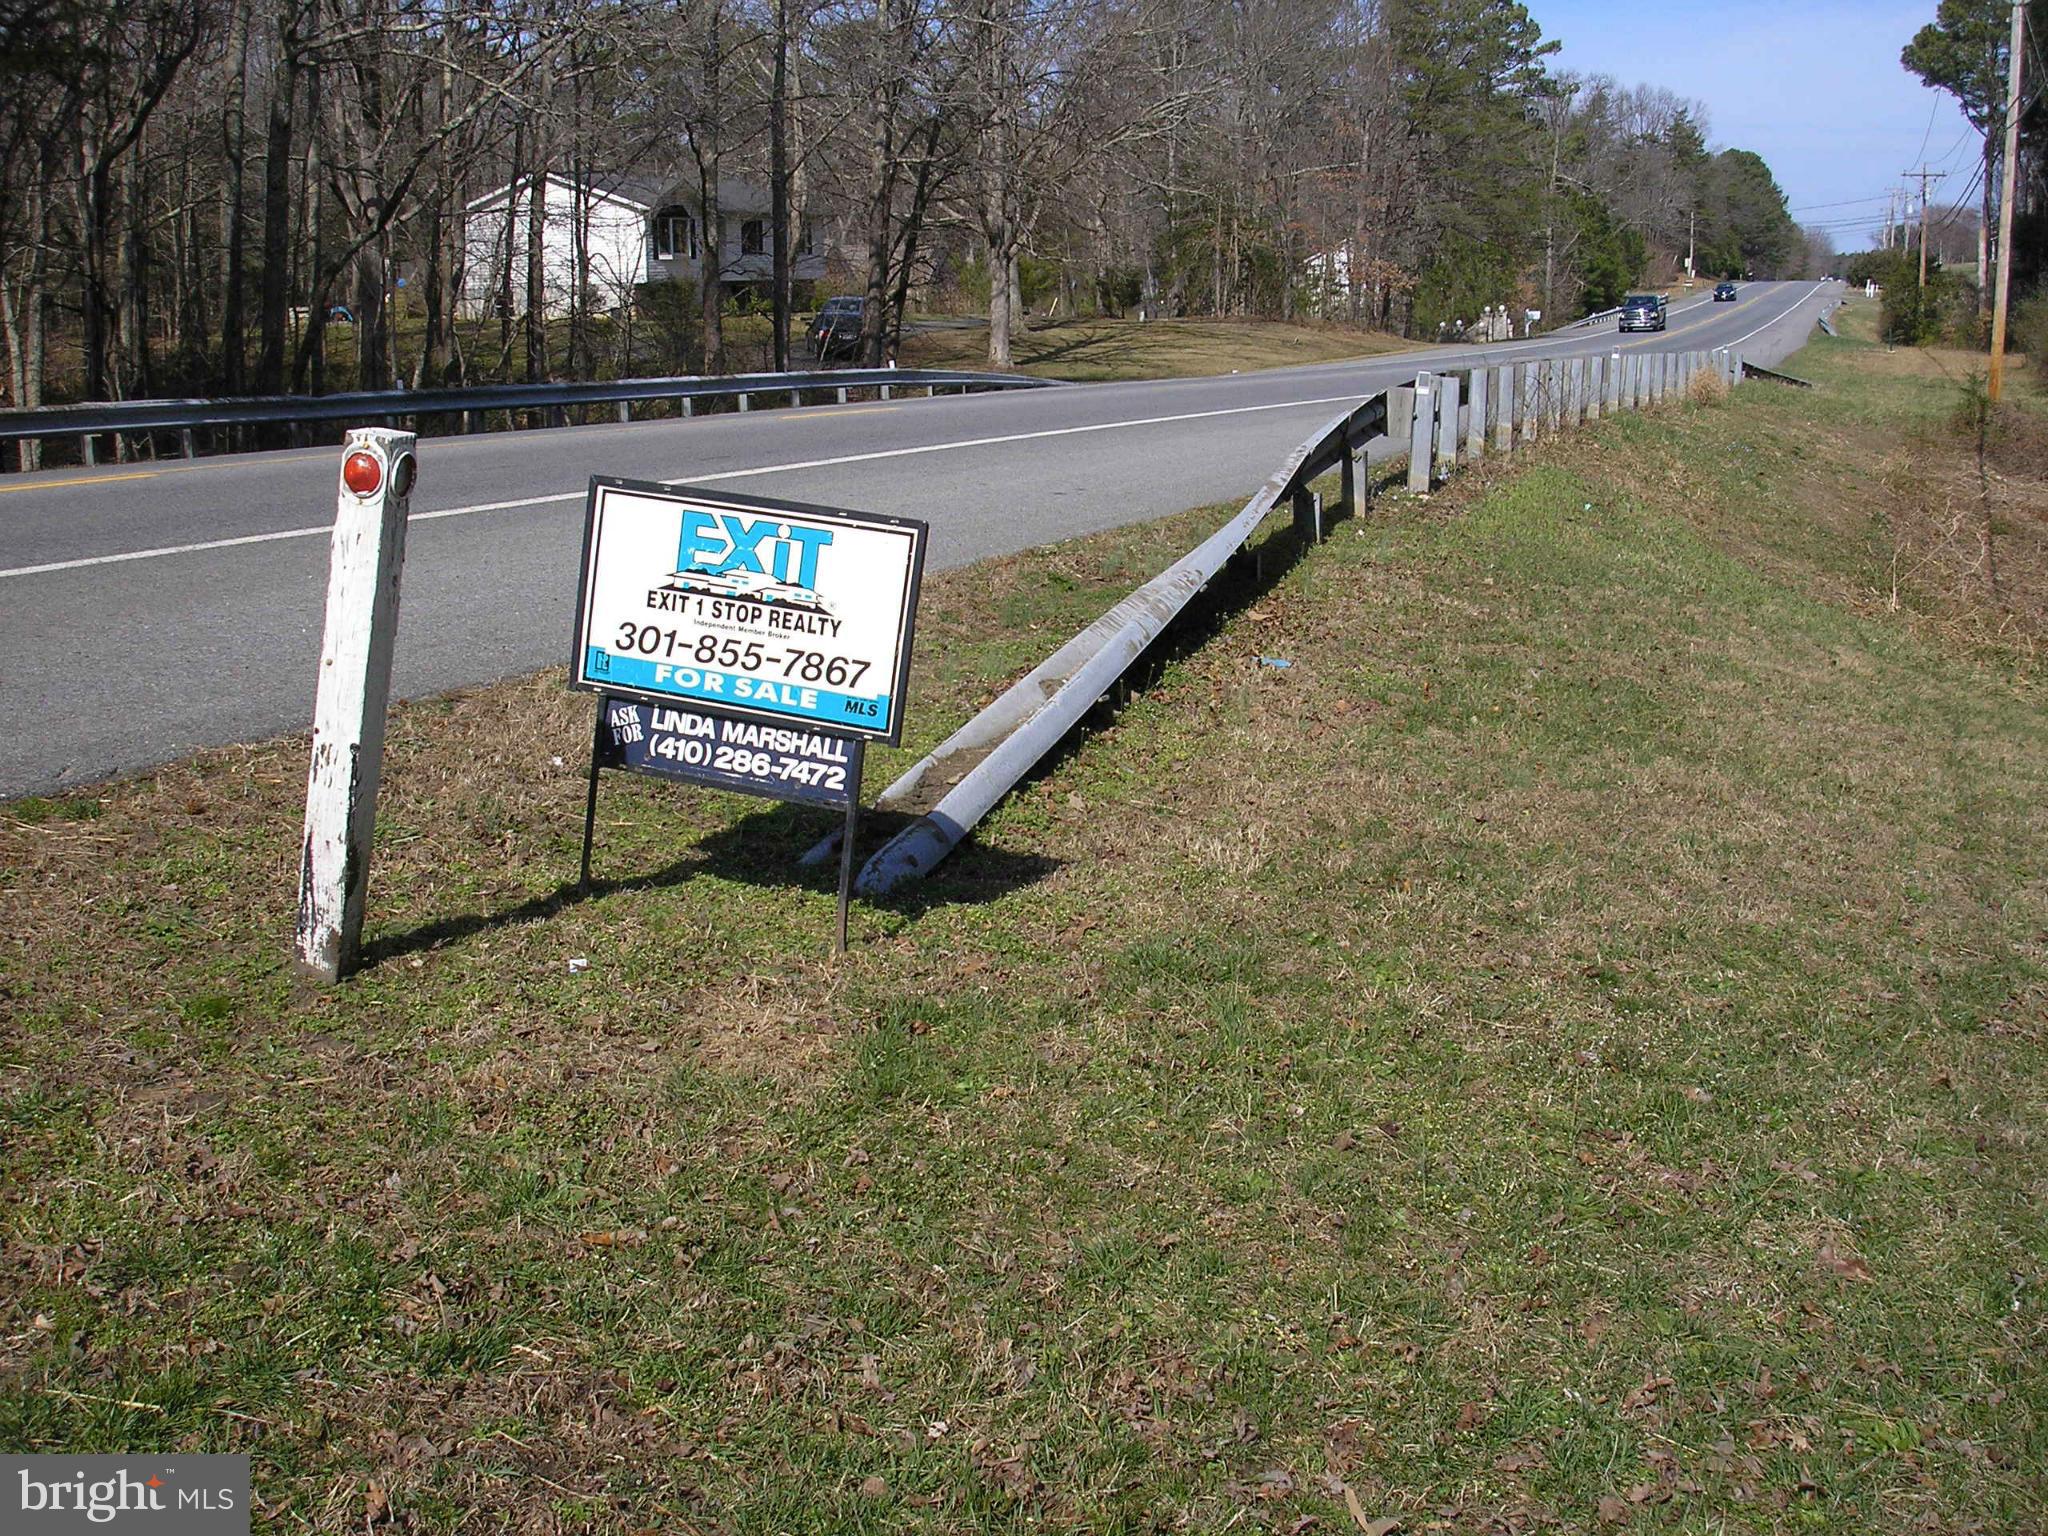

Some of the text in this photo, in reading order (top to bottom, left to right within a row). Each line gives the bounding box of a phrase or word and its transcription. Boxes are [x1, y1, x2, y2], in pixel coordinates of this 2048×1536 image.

[646, 590, 842, 638] EXIT 1 STOP REALTY
[693, 619, 791, 640] Independent Member Broker
[615, 622, 872, 689] 301-855-7867
[655, 663, 819, 710] FOR SALE
[844, 699, 878, 717] MLS
[610, 705, 641, 728] ASK
[613, 722, 644, 746] FOR
[650, 706, 848, 763] LINDA MARSHALL
[649, 734, 847, 791] (410) 286-7472
